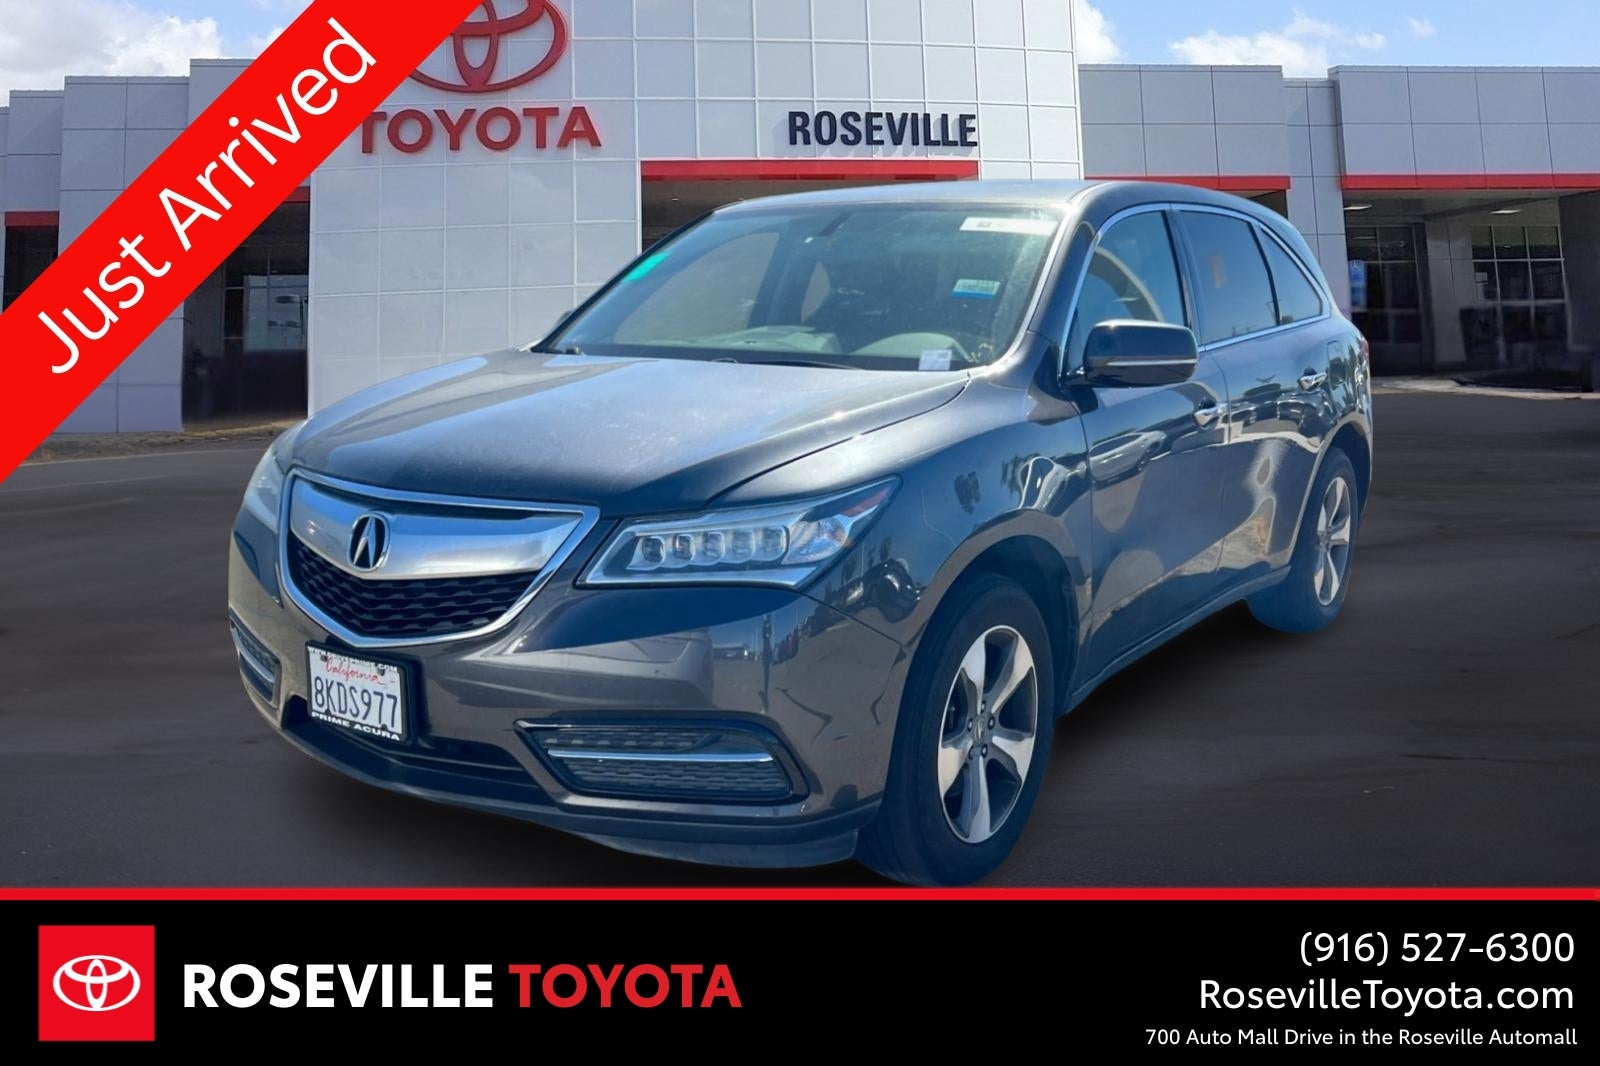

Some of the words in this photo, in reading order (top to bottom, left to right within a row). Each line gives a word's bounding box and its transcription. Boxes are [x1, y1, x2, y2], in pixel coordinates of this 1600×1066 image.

[360, 106, 602, 154] TOYOTA
[788, 111, 978, 147] ROSEVILLE
[324, 656, 387, 685] California
[314, 675, 396, 727] 8KDS977
[311, 711, 350, 726] PRIME
[353, 724, 400, 740] ACURA
